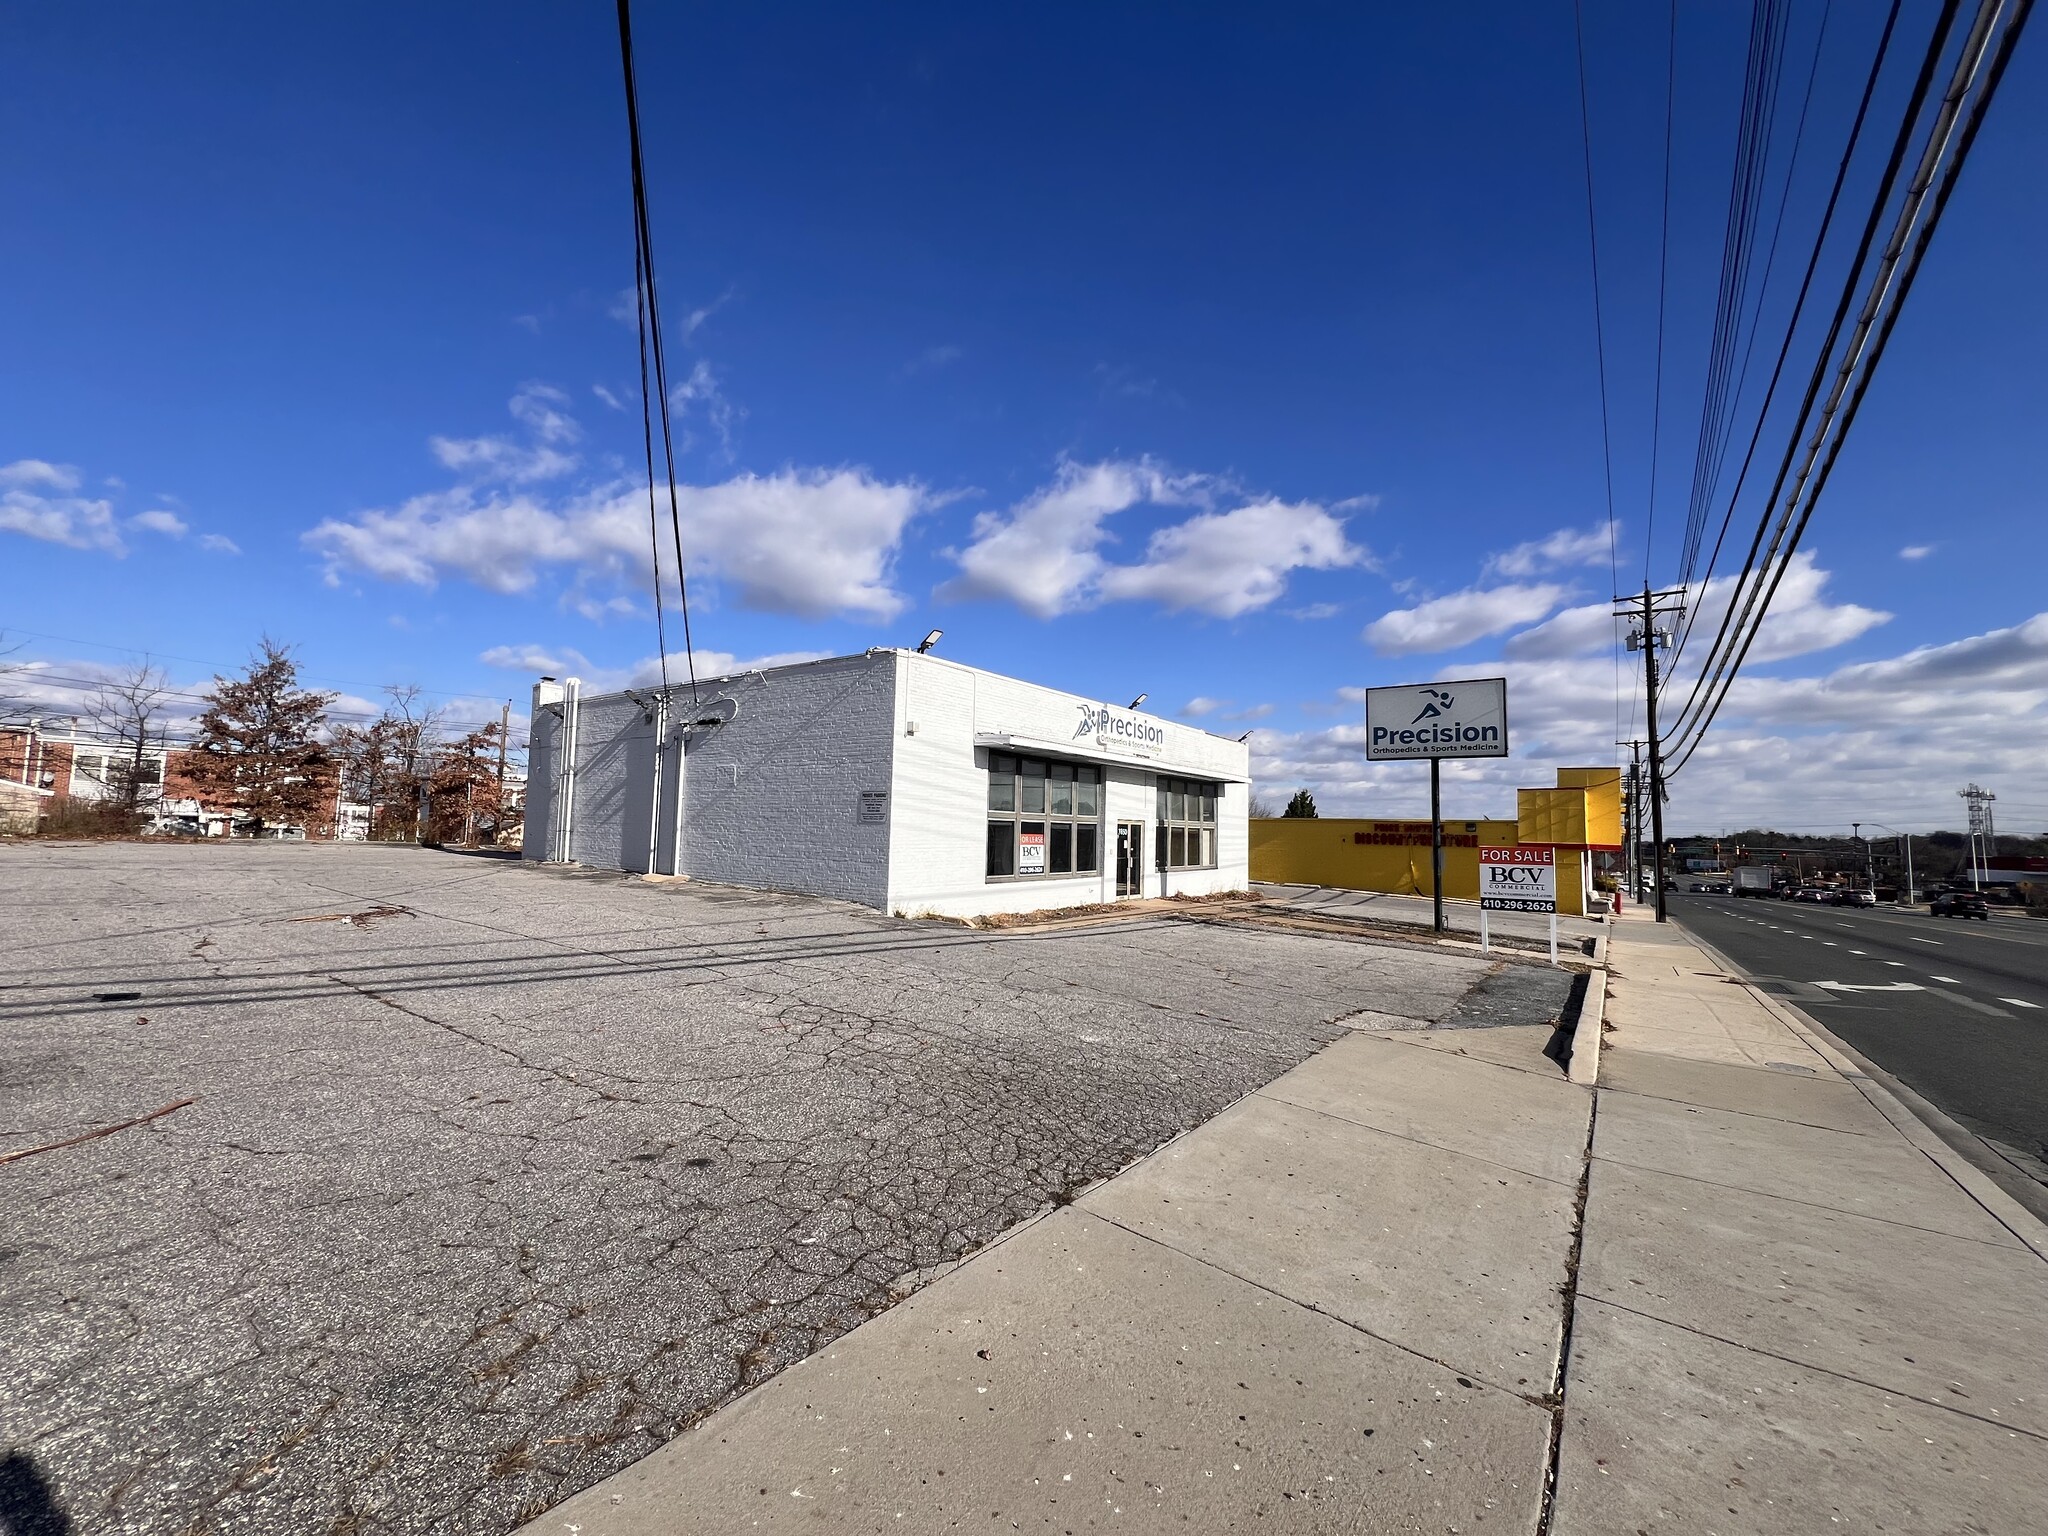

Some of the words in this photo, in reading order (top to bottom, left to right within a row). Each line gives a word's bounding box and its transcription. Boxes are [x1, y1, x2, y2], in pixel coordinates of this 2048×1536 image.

[1101, 709, 1163, 744] Precision
[1373, 722, 1498, 745] Precision
[1373, 746, 1420, 754] Orthopedics
[1431, 745, 1457, 753] Sports
[1022, 846, 1041, 857] BCV
[1481, 850, 1510, 861] FOR
[1514, 851, 1551, 862] SALE
[1489, 866, 1544, 883] BCV
[1483, 899, 1553, 911] 410-296-2626
